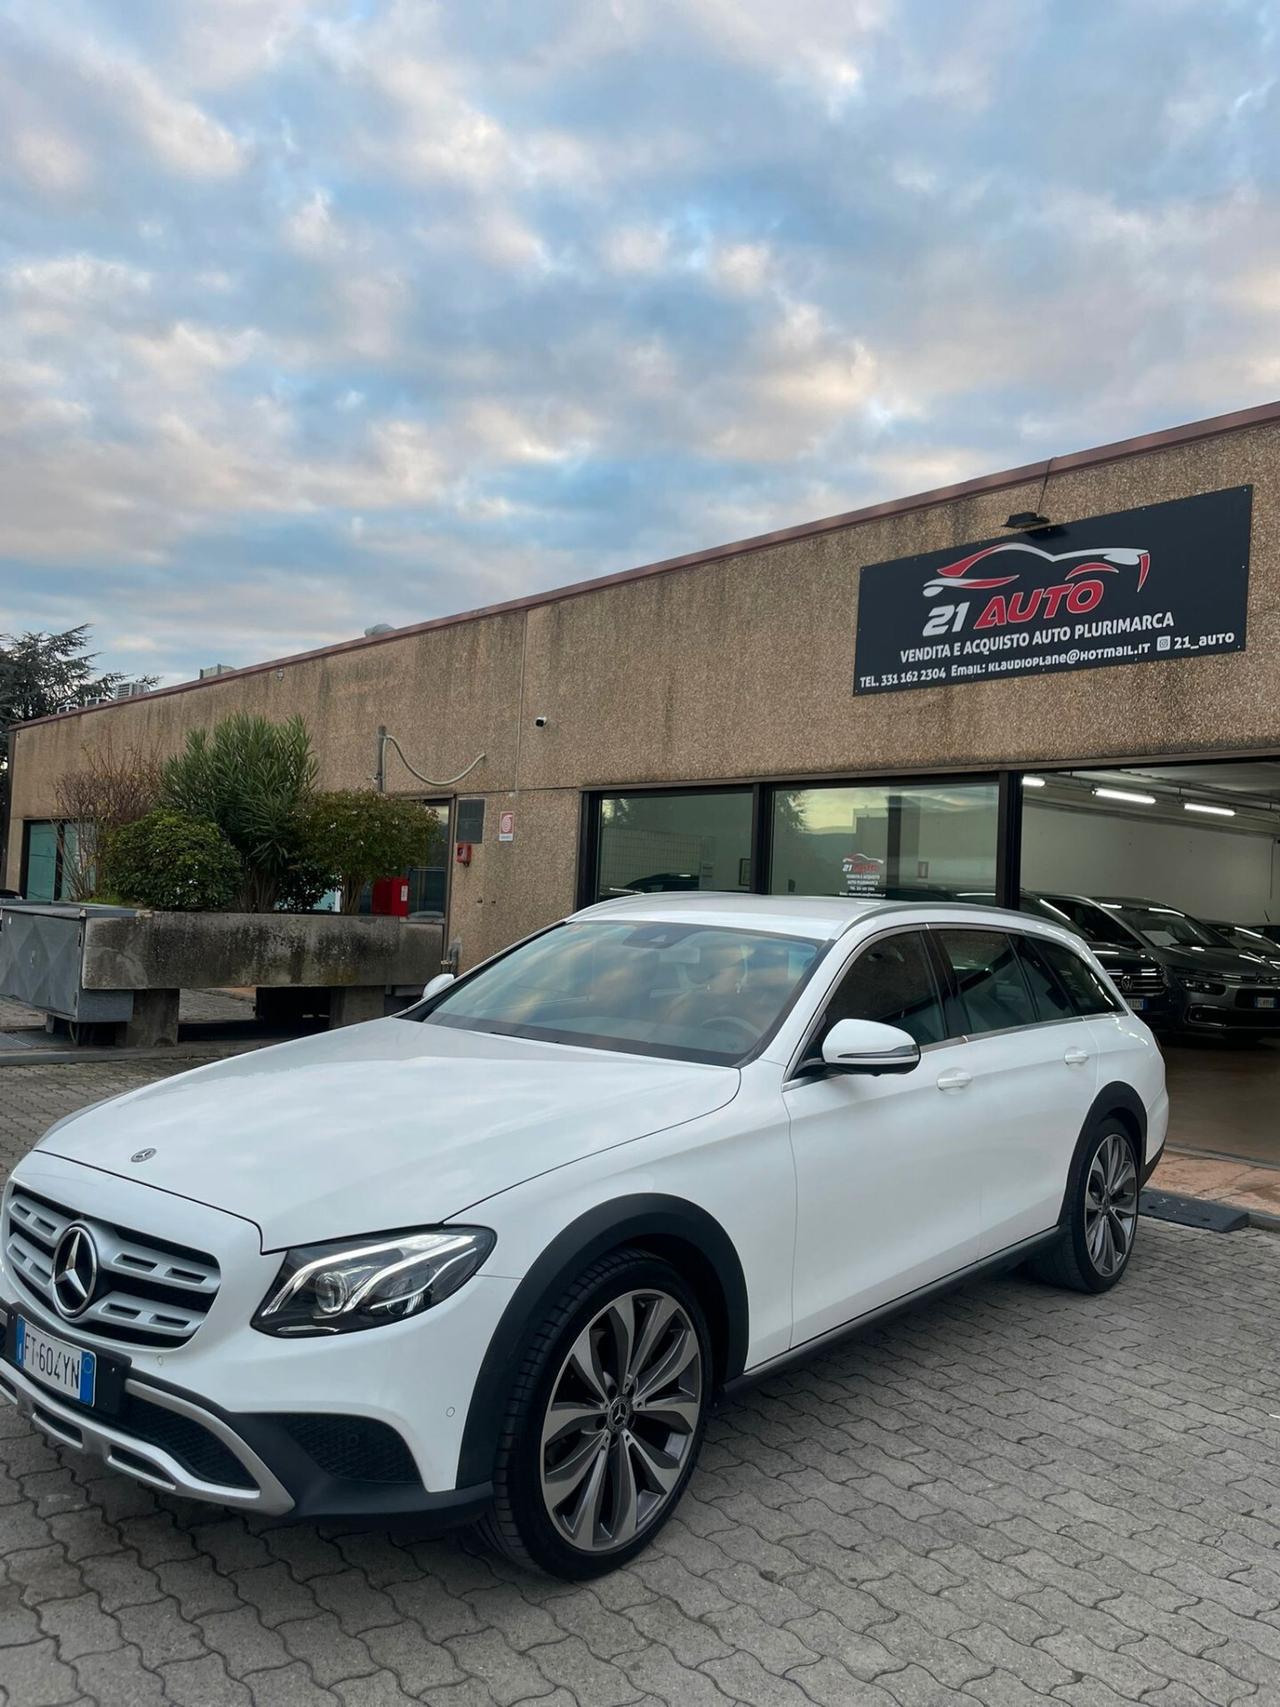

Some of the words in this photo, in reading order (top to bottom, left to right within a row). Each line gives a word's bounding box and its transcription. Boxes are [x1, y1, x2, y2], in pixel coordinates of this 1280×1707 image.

[922, 602, 970, 637] 21
[973, 580, 1104, 629] AUTO
[901, 643, 951, 663] VENDITA
[953, 642, 961, 656] E
[963, 632, 1029, 655] ACQUISTO
[1032, 626, 1071, 645] AUTO
[1074, 612, 1175, 639] PLURIMARCA
[860, 675, 879, 688] TEL.
[881, 673, 898, 686] 331
[900, 671, 919, 683] 162
[920, 667, 946, 680] 2304
